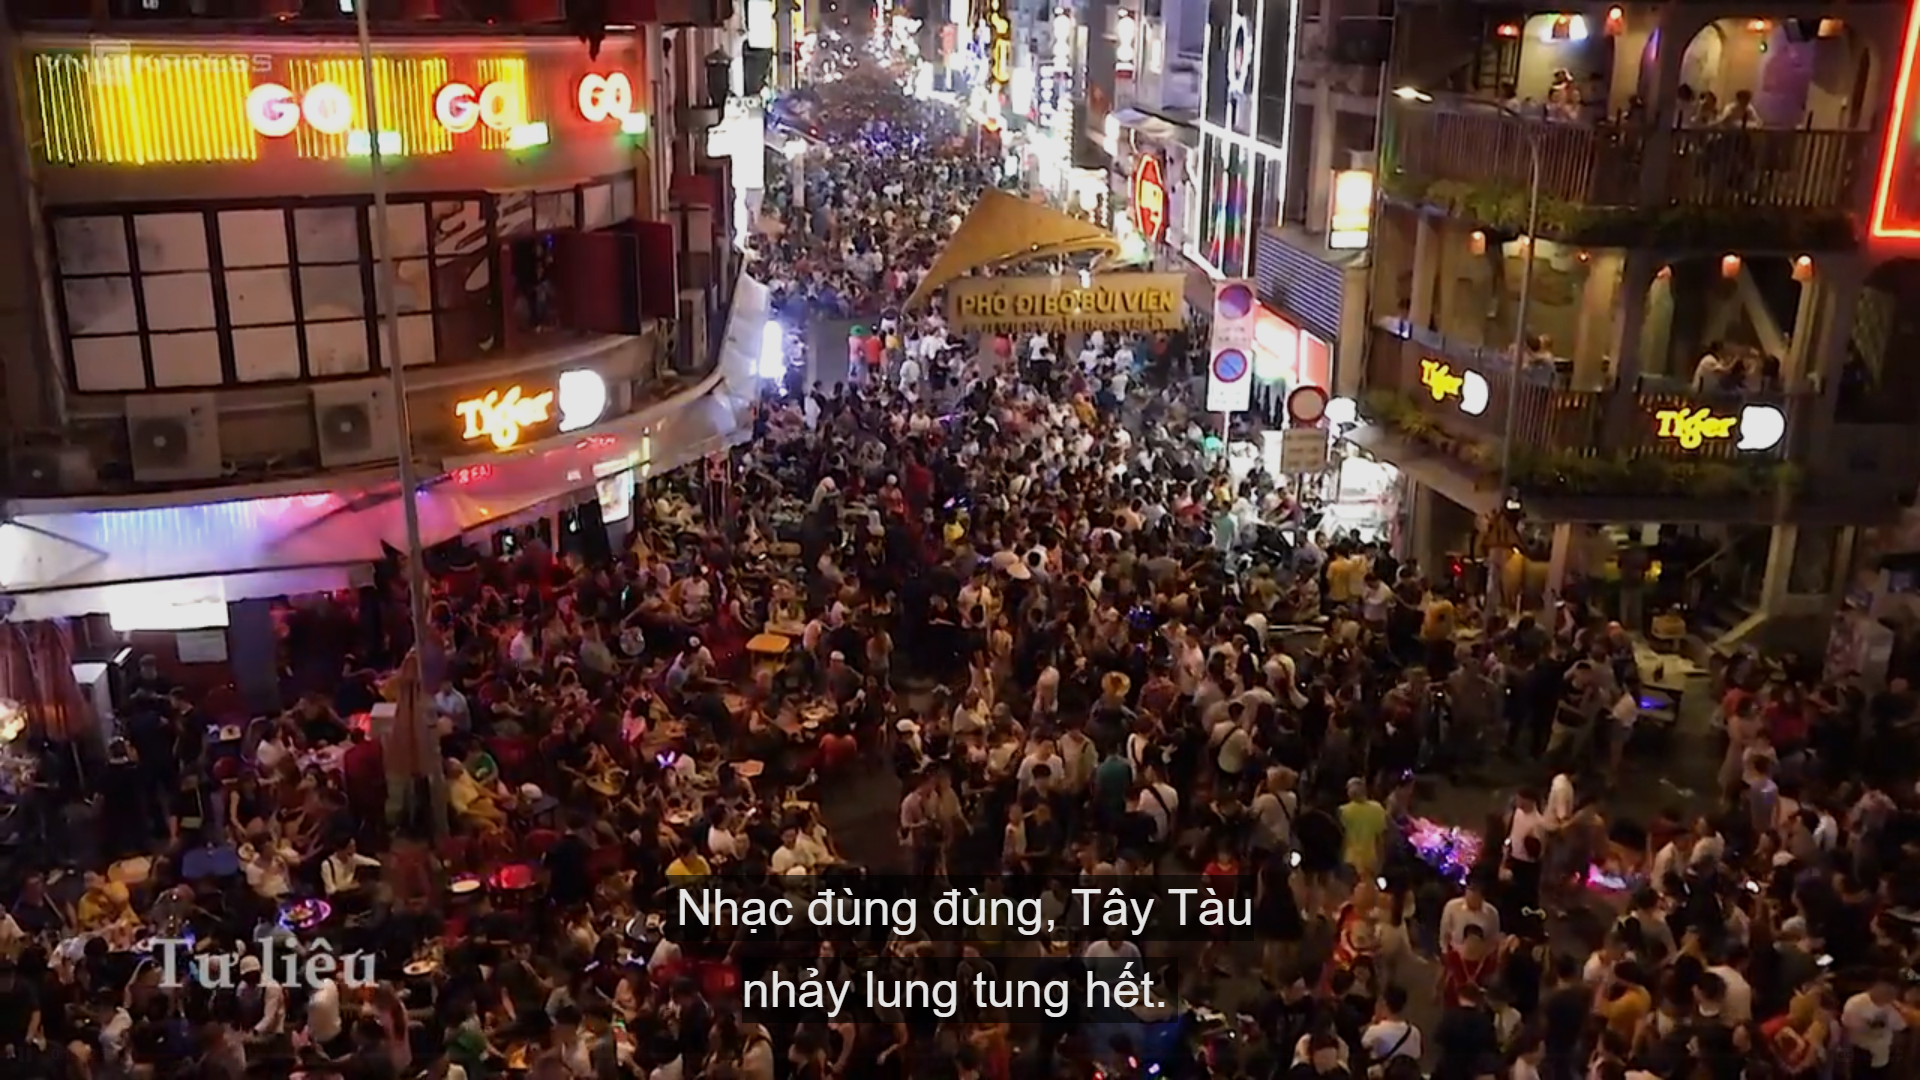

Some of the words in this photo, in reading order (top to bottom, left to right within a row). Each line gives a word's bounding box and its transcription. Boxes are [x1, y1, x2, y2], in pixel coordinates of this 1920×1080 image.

[246, 83, 351, 136] GO
[437, 81, 523, 133] GO
[579, 72, 632, 122] GO
[1420, 359, 1463, 400] Tiger
[456, 386, 553, 448] Tiger
[1656, 408, 1737, 449] Tiger
